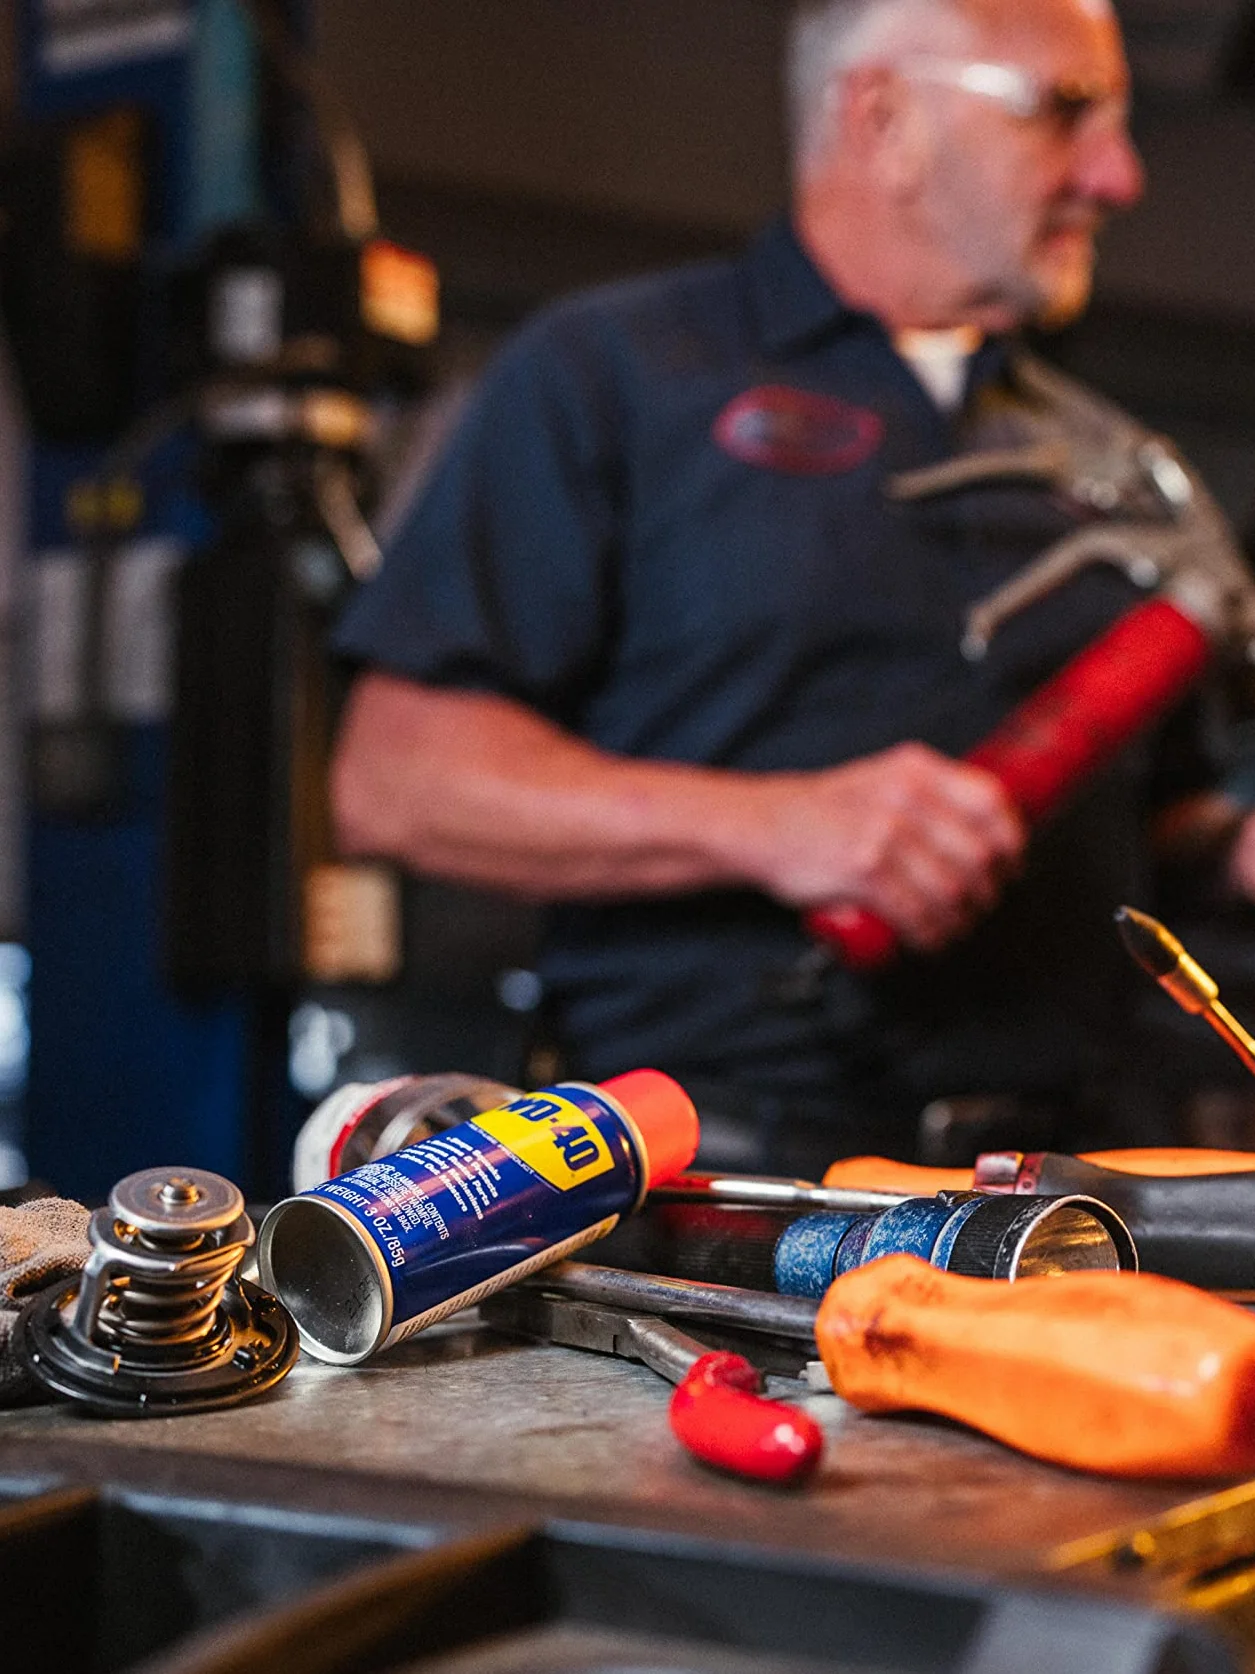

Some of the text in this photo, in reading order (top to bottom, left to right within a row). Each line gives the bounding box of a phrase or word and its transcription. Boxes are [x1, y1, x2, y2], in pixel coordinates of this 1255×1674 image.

[498, 1098, 600, 1172] WD-40
[324, 1184, 371, 1208] WEIGHT
[364, 1206, 379, 1217] 3
[372, 1216, 406, 1268] OZ./85g
[424, 1202, 450, 1240] CONTENTS
